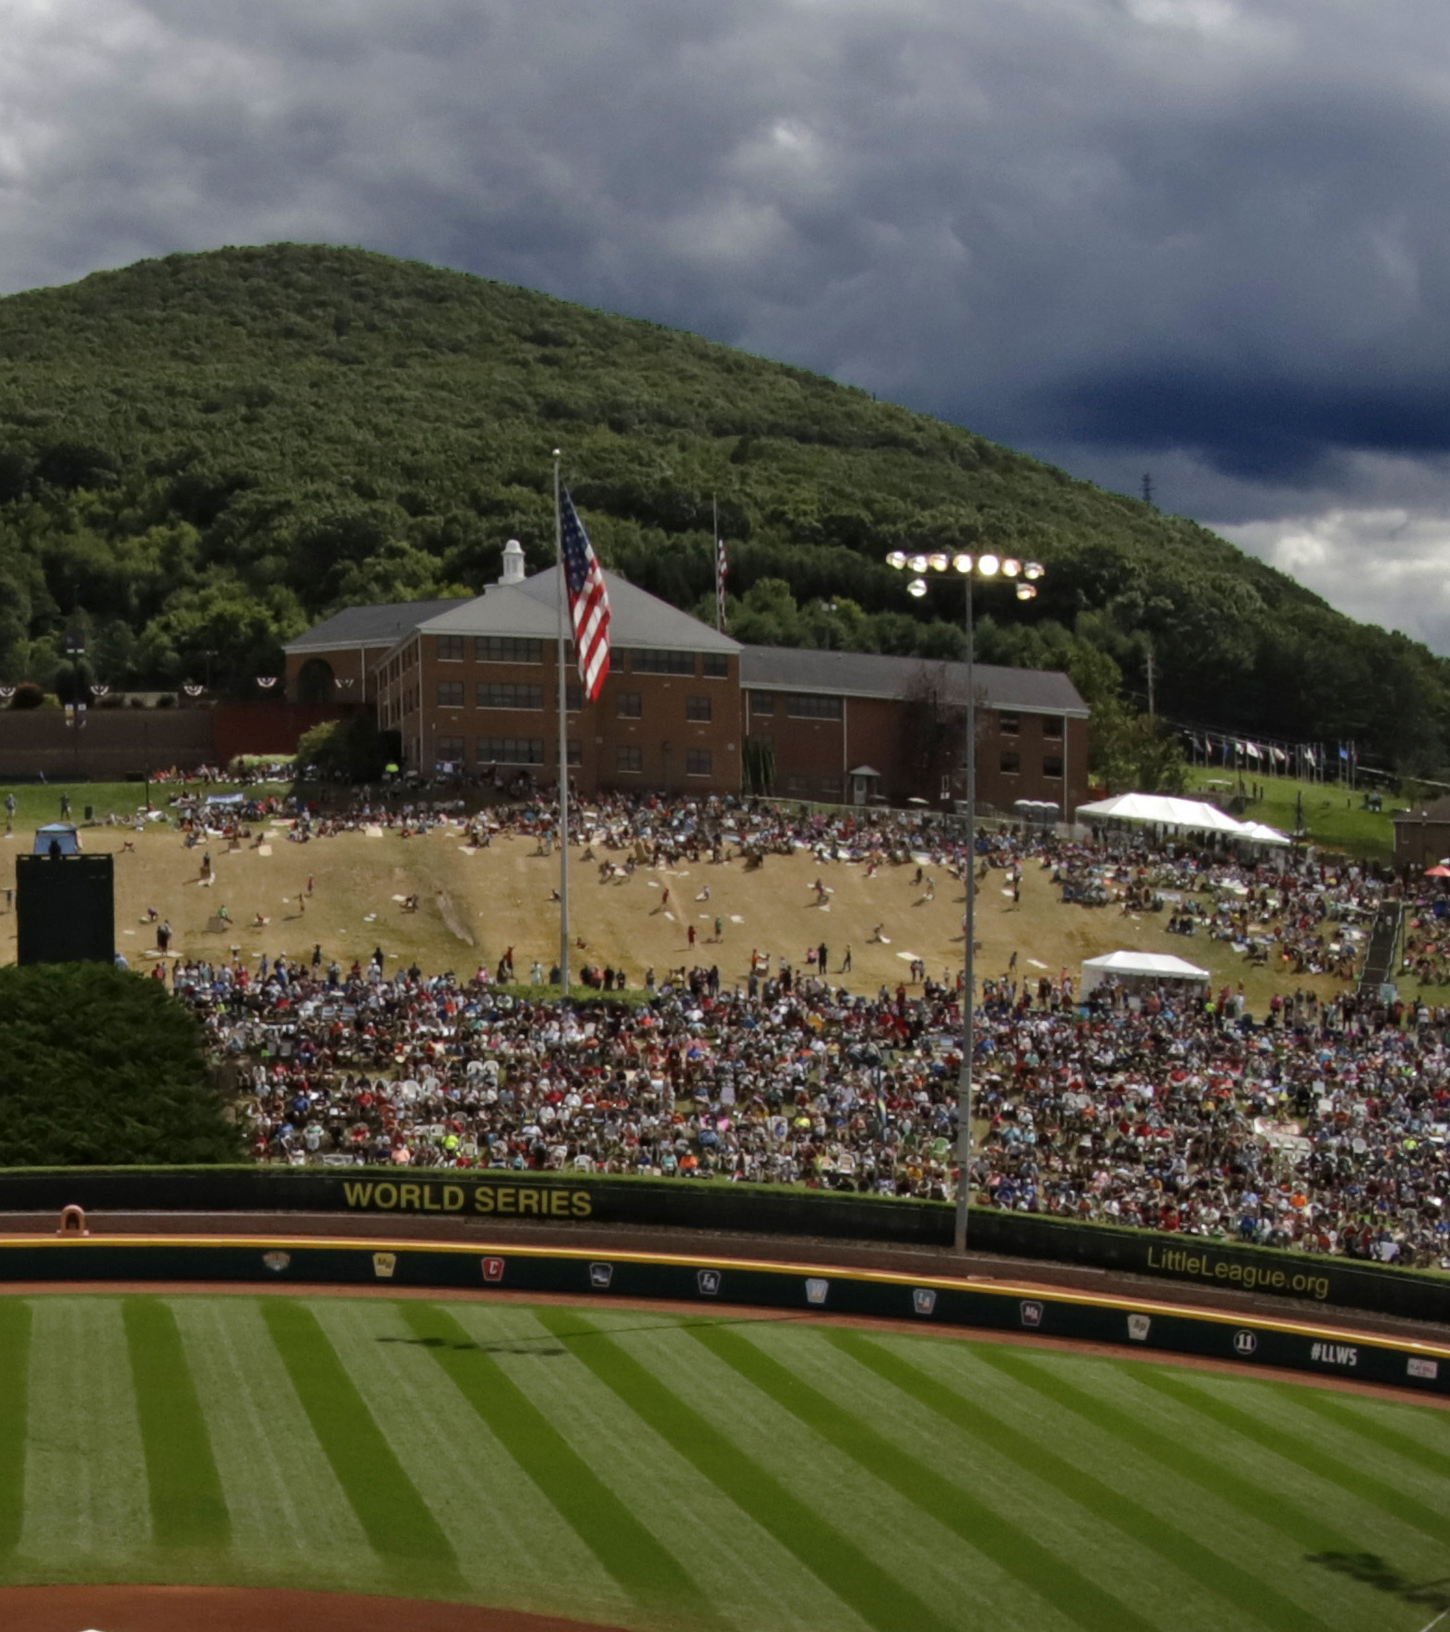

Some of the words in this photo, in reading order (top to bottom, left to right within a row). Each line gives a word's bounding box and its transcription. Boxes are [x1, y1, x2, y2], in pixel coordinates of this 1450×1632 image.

[343, 1183, 464, 1211] WORLD
[474, 1187, 592, 1219] SERIES
[1147, 1246, 1329, 1299] LittleLeague.org
[1311, 1342, 1357, 1366] #LLWS
